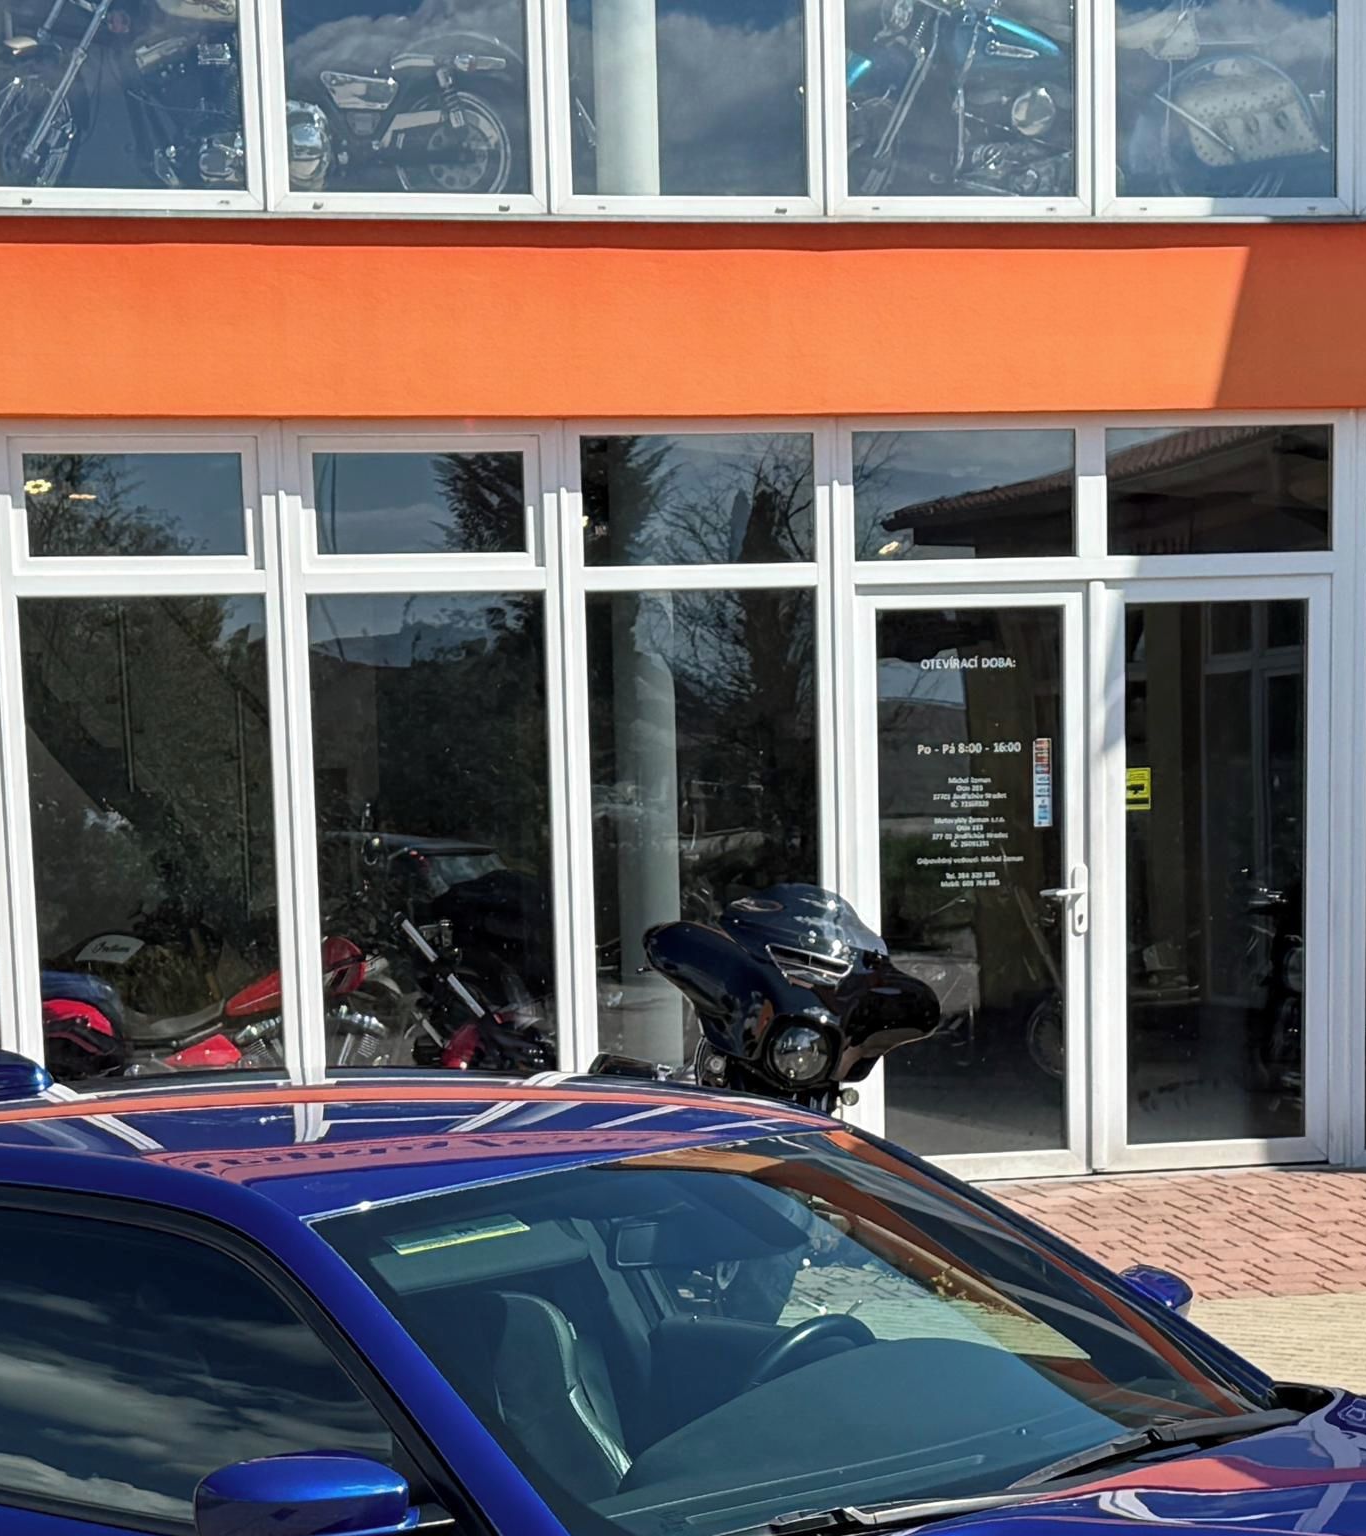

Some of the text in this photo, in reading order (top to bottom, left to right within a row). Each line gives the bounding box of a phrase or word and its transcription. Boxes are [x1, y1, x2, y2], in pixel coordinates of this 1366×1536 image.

[920, 656, 1017, 670] OTEVÍRACÍ DOBA:
[917, 744, 932, 755] Po
[942, 742, 955, 754] Pá
[958, 743, 983, 753] 8:00
[993, 742, 1022, 753] 16:00
